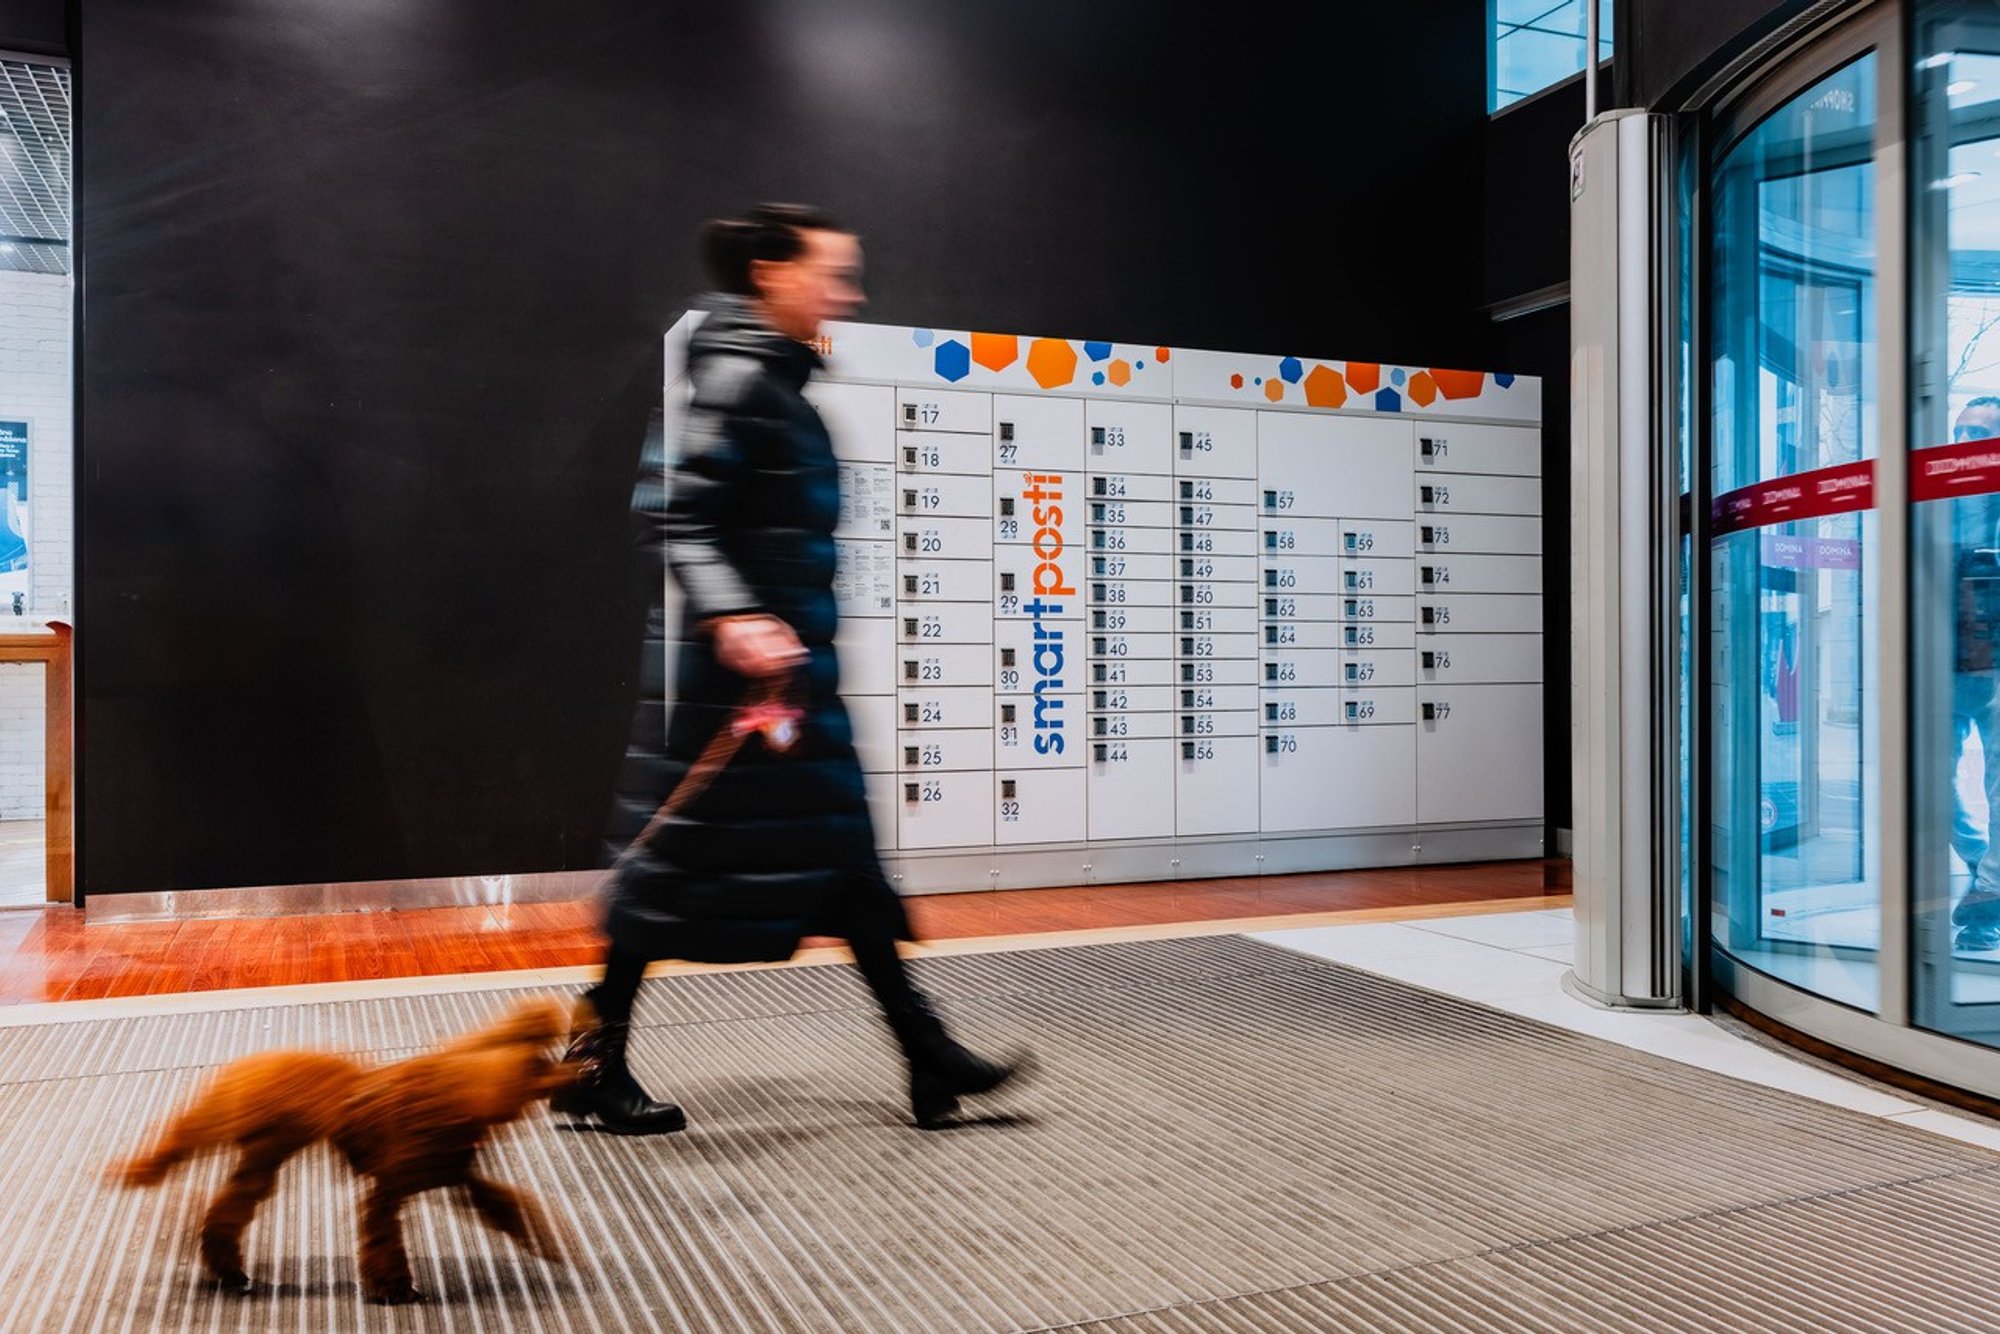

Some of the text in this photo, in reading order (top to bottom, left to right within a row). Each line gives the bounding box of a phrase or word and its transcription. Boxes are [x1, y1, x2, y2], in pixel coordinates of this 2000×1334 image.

[921, 410, 940, 424] 17
[1107, 434, 1125, 446] 33
[1195, 439, 1213, 451] 45
[1000, 446, 1017, 458] 27
[1434, 444, 1448, 456] 71
[922, 453, 940, 466] 18
[1108, 484, 1126, 496] 34
[1195, 488, 1213, 500] 46
[922, 495, 940, 508] 19
[1279, 496, 1294, 508] 57
[1434, 492, 1449, 504] 72
[1108, 510, 1126, 523] 35
[1196, 513, 1213, 525] 47
[1000, 521, 1018, 534] 28
[1108, 537, 1126, 549] 36
[1279, 537, 1295, 549] 58
[1434, 532, 1449, 544] 73
[922, 538, 941, 551] 20
[1196, 539, 1213, 551] 48
[1359, 538, 1374, 551] 59
[1774, 542, 1803, 553] DOMINA
[1819, 545, 1851, 556] DOMINA
[1108, 563, 1126, 575] 37
[1196, 565, 1213, 577] 49
[1279, 575, 1295, 587] 60
[1359, 576, 1374, 588] 61
[1435, 571, 1449, 584] 74
[922, 580, 940, 594] 21
[1109, 589, 1126, 602] 38
[1196, 591, 1213, 603] 50
[1001, 596, 1018, 609] 29
[1023, 472, 1076, 755] smartposti
[1279, 604, 1295, 617] 62
[1359, 605, 1374, 617] 63
[1109, 616, 1126, 629] 39
[1435, 611, 1450, 623] 75
[1196, 617, 1213, 630] 51
[922, 623, 941, 638] 22
[1279, 632, 1295, 644] 64
[1359, 632, 1374, 644] 65
[1110, 643, 1127, 656] 40
[1196, 643, 1213, 655] 52
[1435, 656, 1450, 668] 76
[923, 666, 941, 680] 23
[1001, 671, 1019, 684] 30
[1110, 670, 1126, 682] 41
[1197, 669, 1213, 681] 53
[1279, 668, 1296, 680] 66
[1359, 668, 1374, 680] 67
[1110, 696, 1128, 709] 42
[1197, 695, 1213, 708] 54
[923, 709, 942, 722] 24
[1279, 708, 1296, 720] 68
[1359, 706, 1375, 718] 69
[1436, 707, 1450, 719] 77
[1001, 727, 1018, 740] 31
[1110, 723, 1128, 735] 43
[1197, 721, 1214, 734] 55
[1280, 740, 1296, 752] 70
[923, 751, 942, 765] 25
[1110, 749, 1128, 761] 44
[1197, 747, 1214, 759] 56
[923, 788, 942, 801] 26
[1001, 803, 1019, 815] 32
